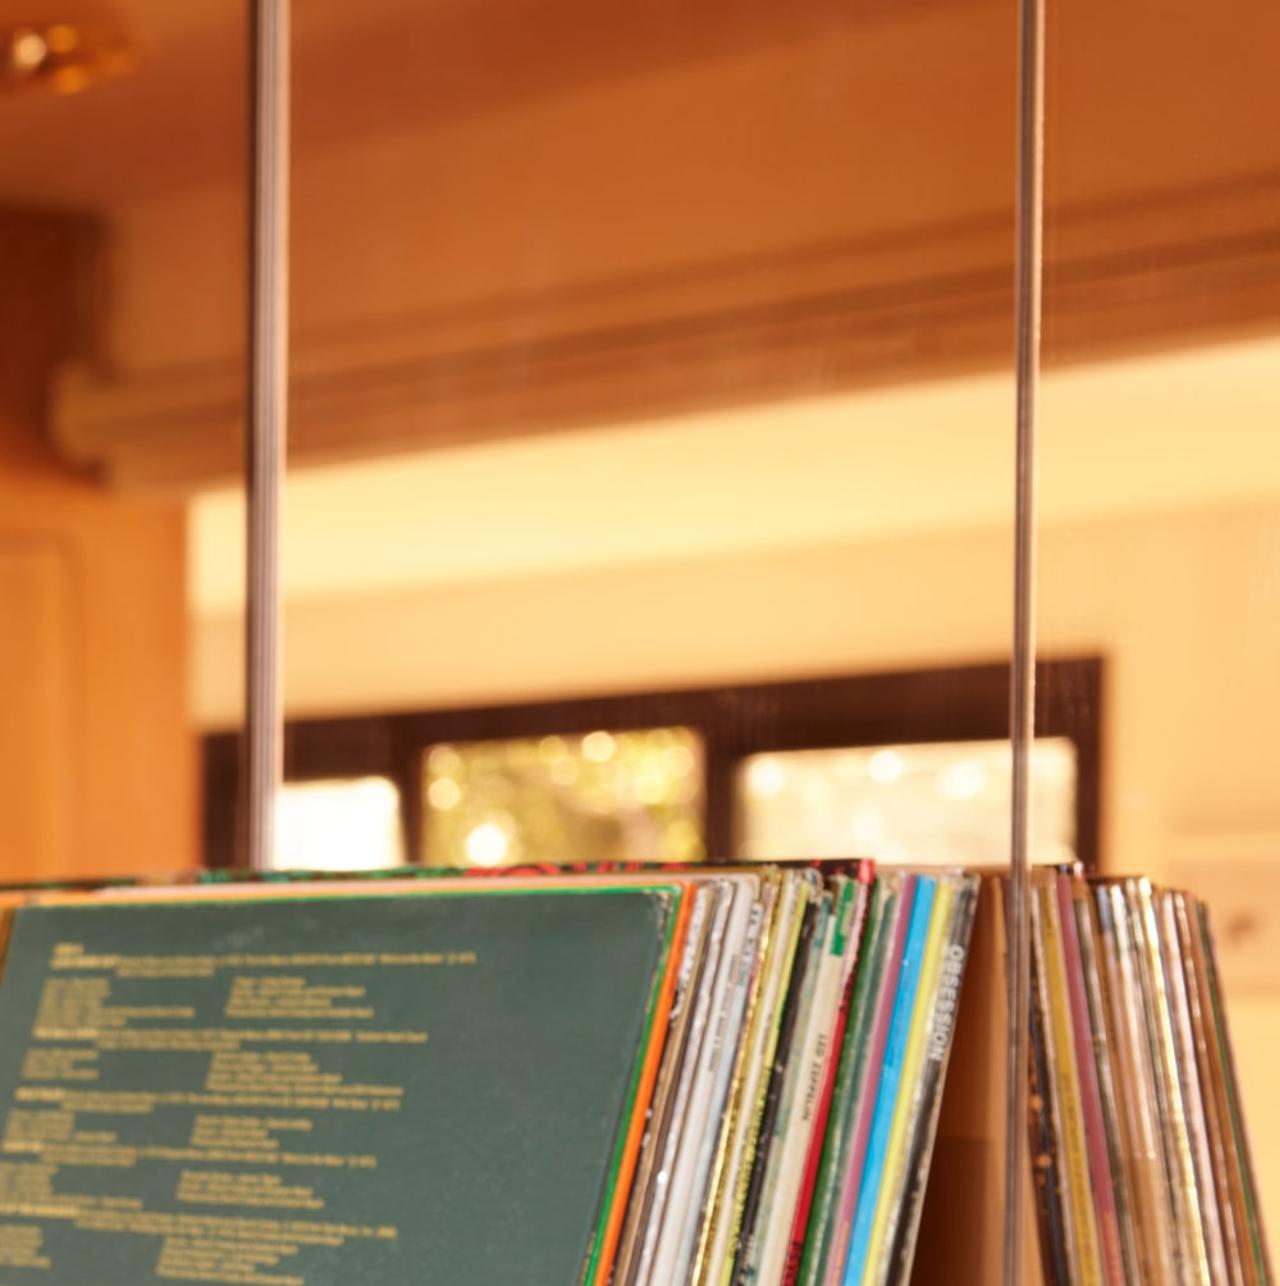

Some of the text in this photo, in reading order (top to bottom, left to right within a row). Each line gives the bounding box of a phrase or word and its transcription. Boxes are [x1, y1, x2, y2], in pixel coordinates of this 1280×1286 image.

[927, 944, 965, 1062] OBSESSION
[800, 1033, 828, 1121] LED ZEPPELIN
